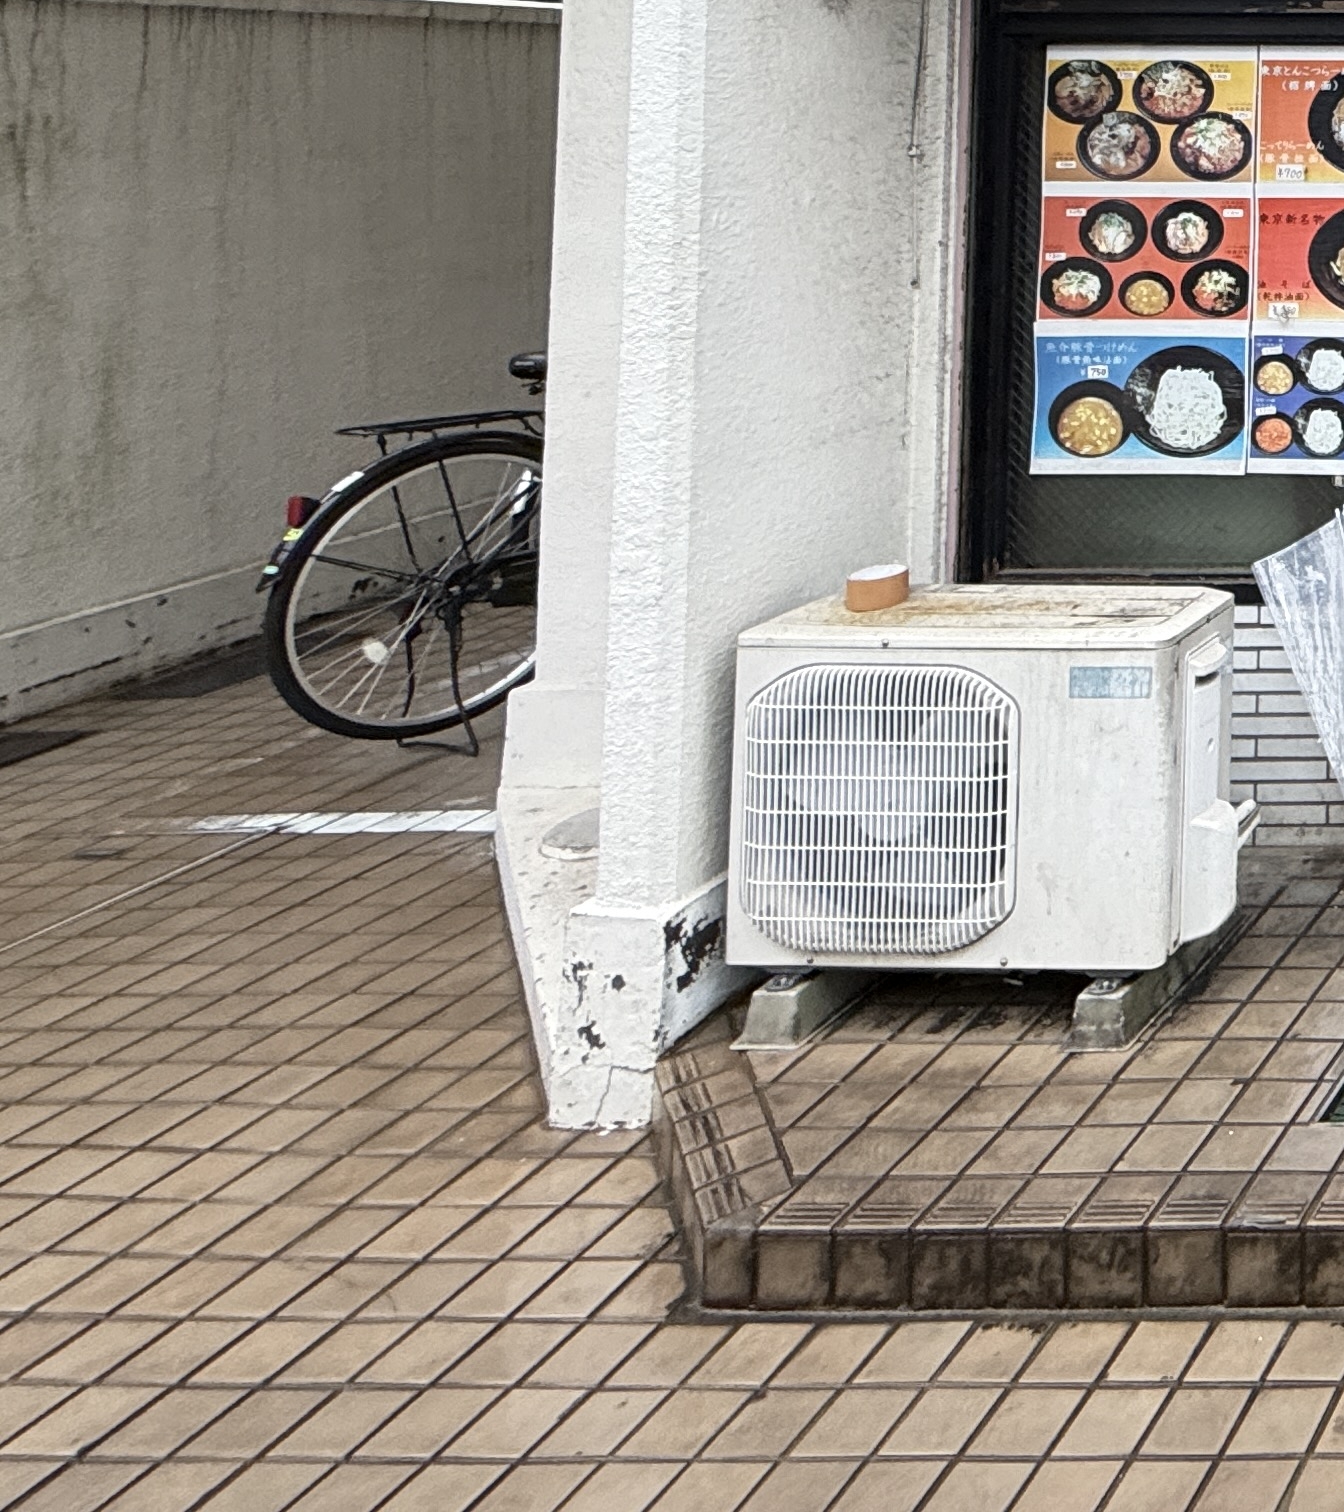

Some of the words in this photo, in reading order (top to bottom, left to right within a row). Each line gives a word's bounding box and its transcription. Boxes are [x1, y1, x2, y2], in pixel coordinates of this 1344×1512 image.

[1277, 168, 1303, 179] ¥700
[1260, 213, 1325, 225] 東京新名物
